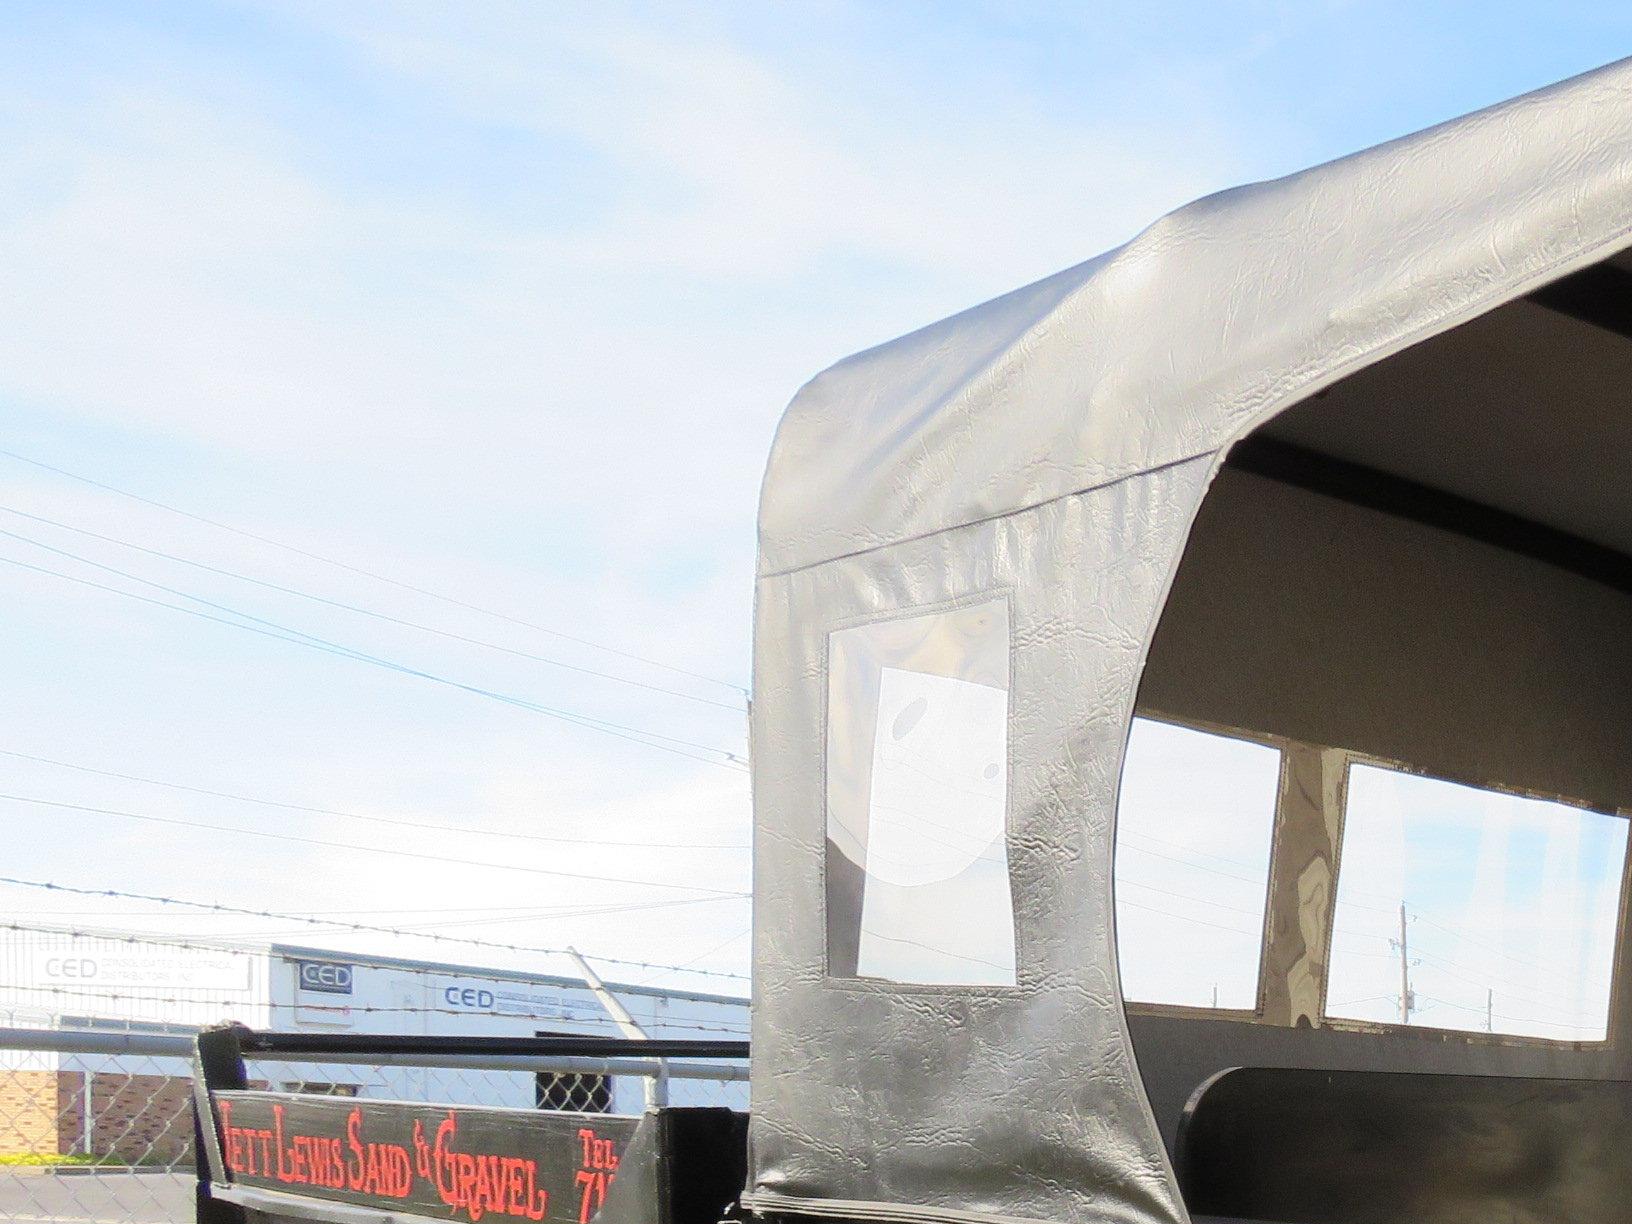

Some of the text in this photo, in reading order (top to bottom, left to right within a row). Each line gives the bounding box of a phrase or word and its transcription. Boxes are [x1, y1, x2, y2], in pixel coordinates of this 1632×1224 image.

[45, 958, 98, 978] CED
[302, 963, 351, 986] CED
[445, 986, 495, 1009] CED
[273, 1104, 346, 1190] LEWIS
[347, 1104, 412, 1199] SAND
[434, 1109, 549, 1222] GRAVEL
